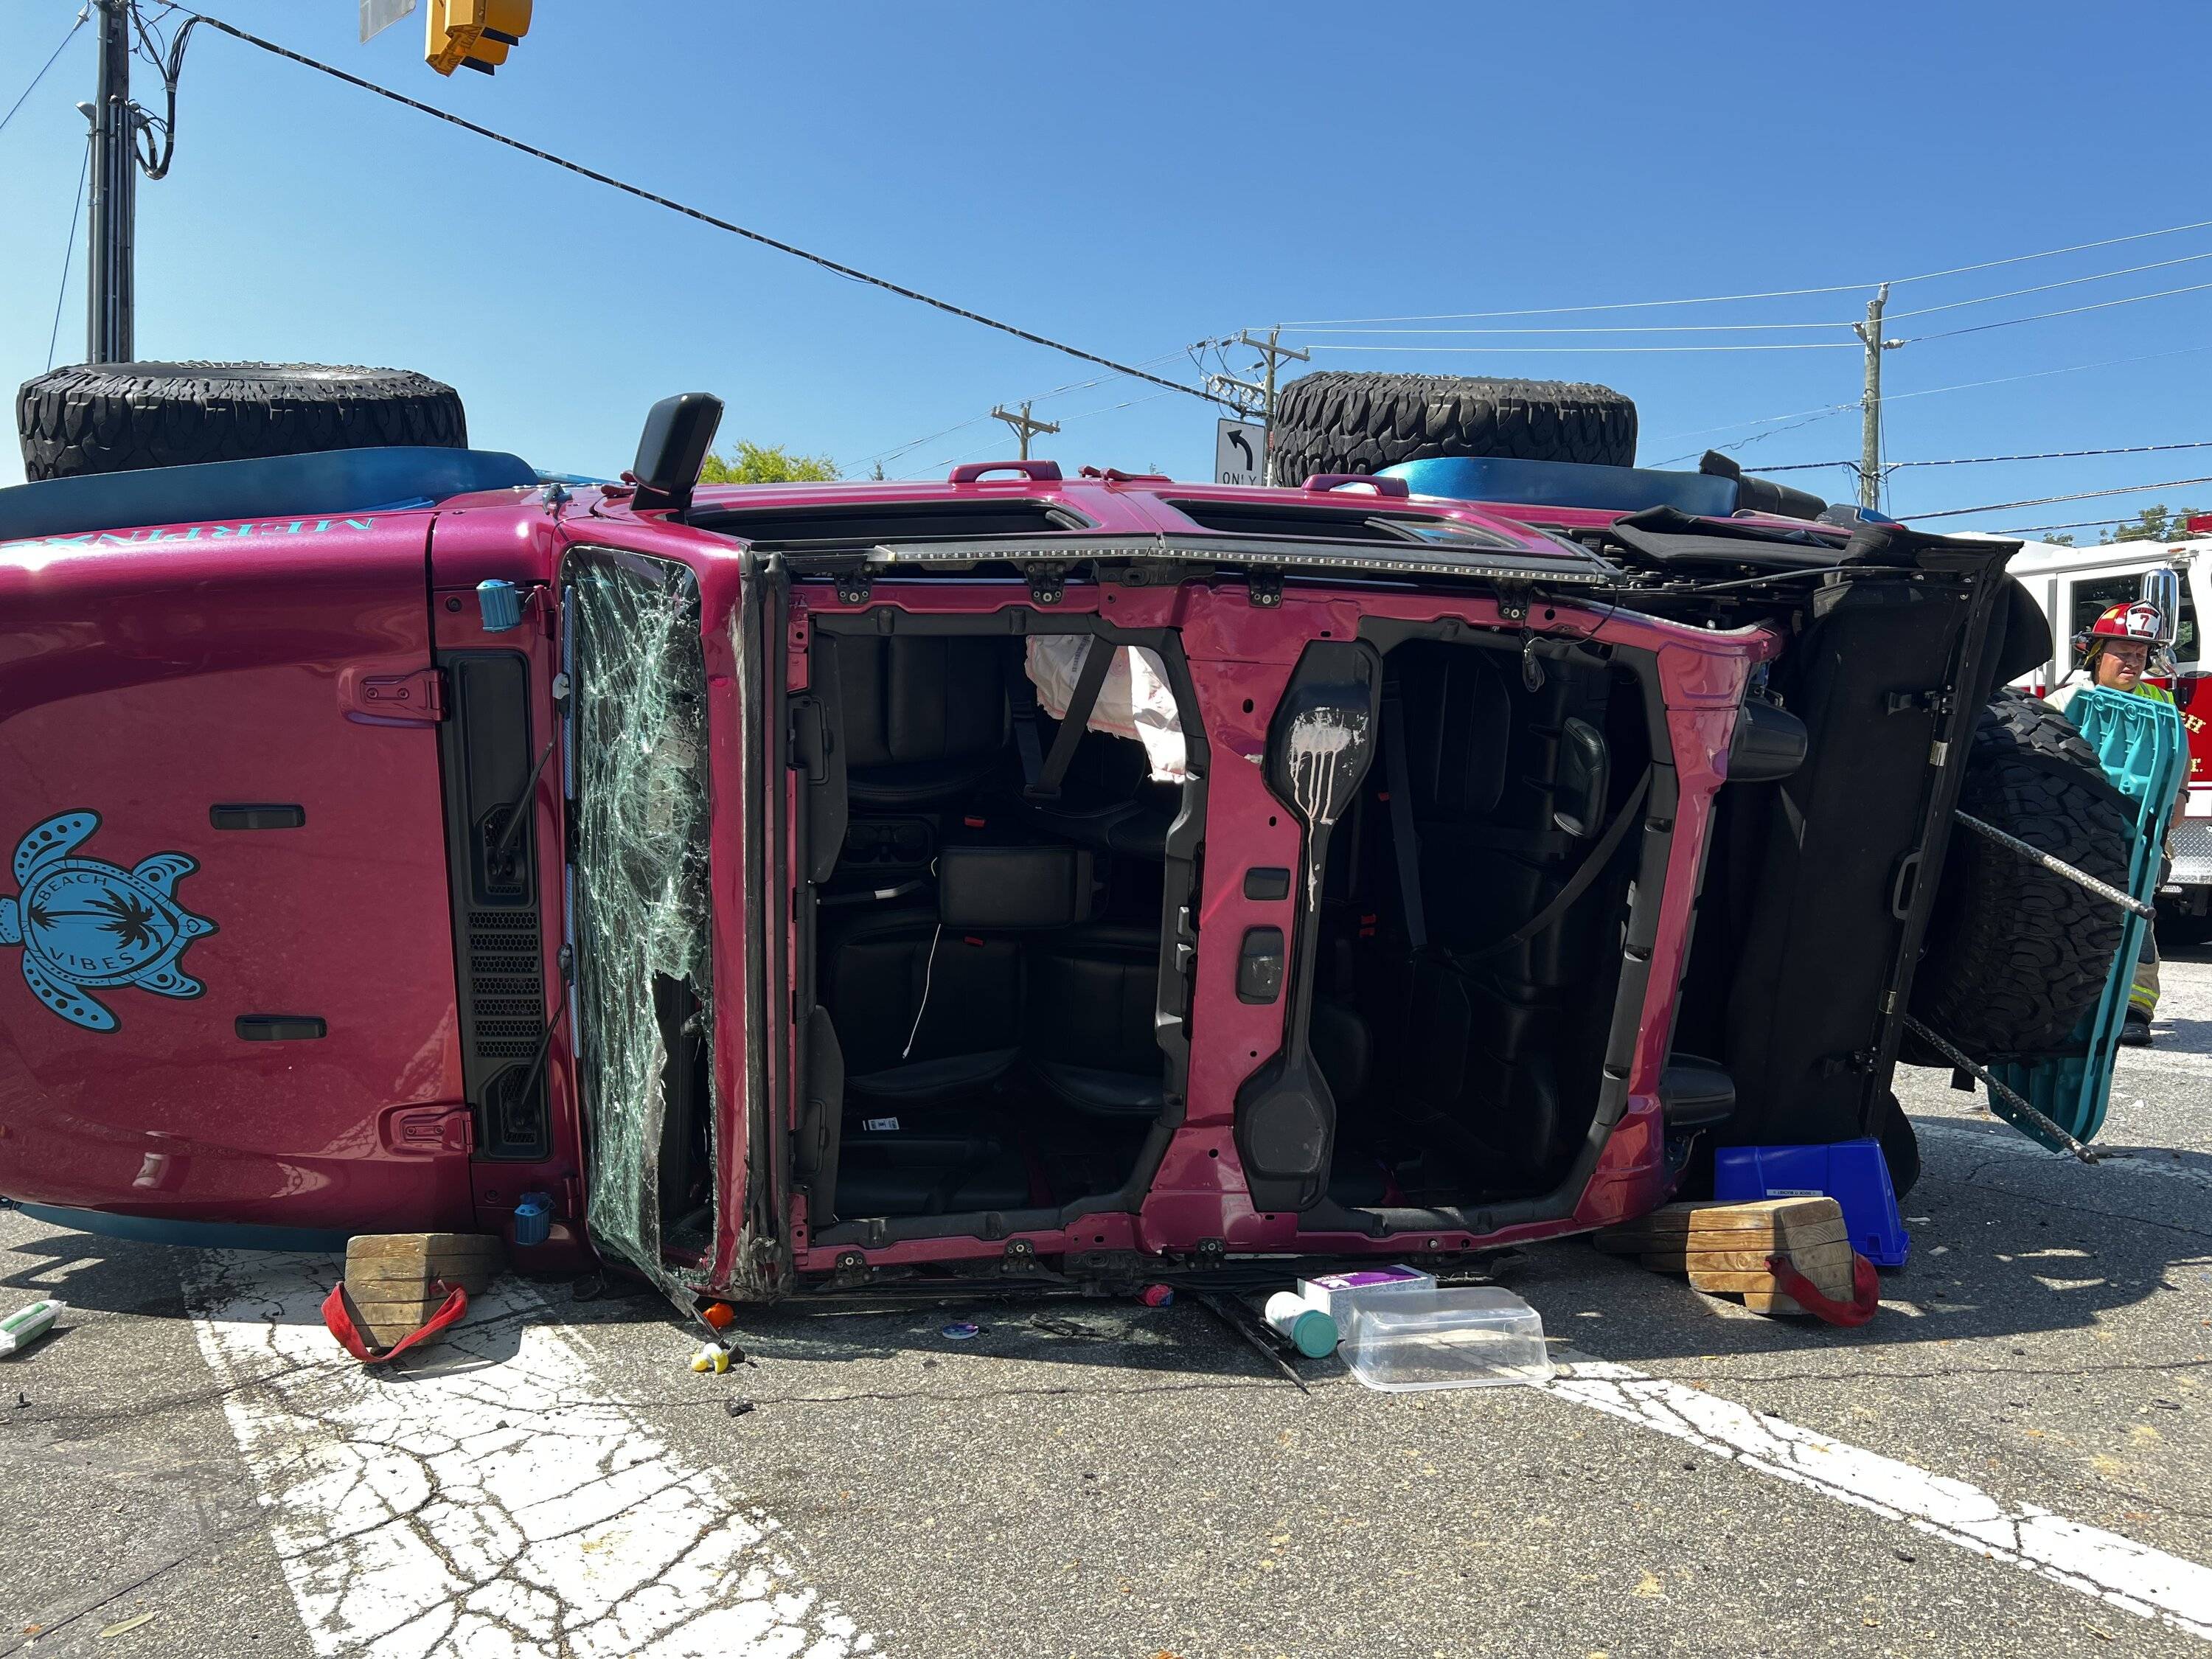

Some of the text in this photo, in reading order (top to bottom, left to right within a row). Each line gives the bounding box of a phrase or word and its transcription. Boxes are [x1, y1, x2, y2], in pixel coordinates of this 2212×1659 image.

[1222, 471, 1256, 485] ONLY
[2140, 614, 2149, 630] 7
[38, 874, 107, 901] BEACH
[49, 946, 135, 971] VIBES
